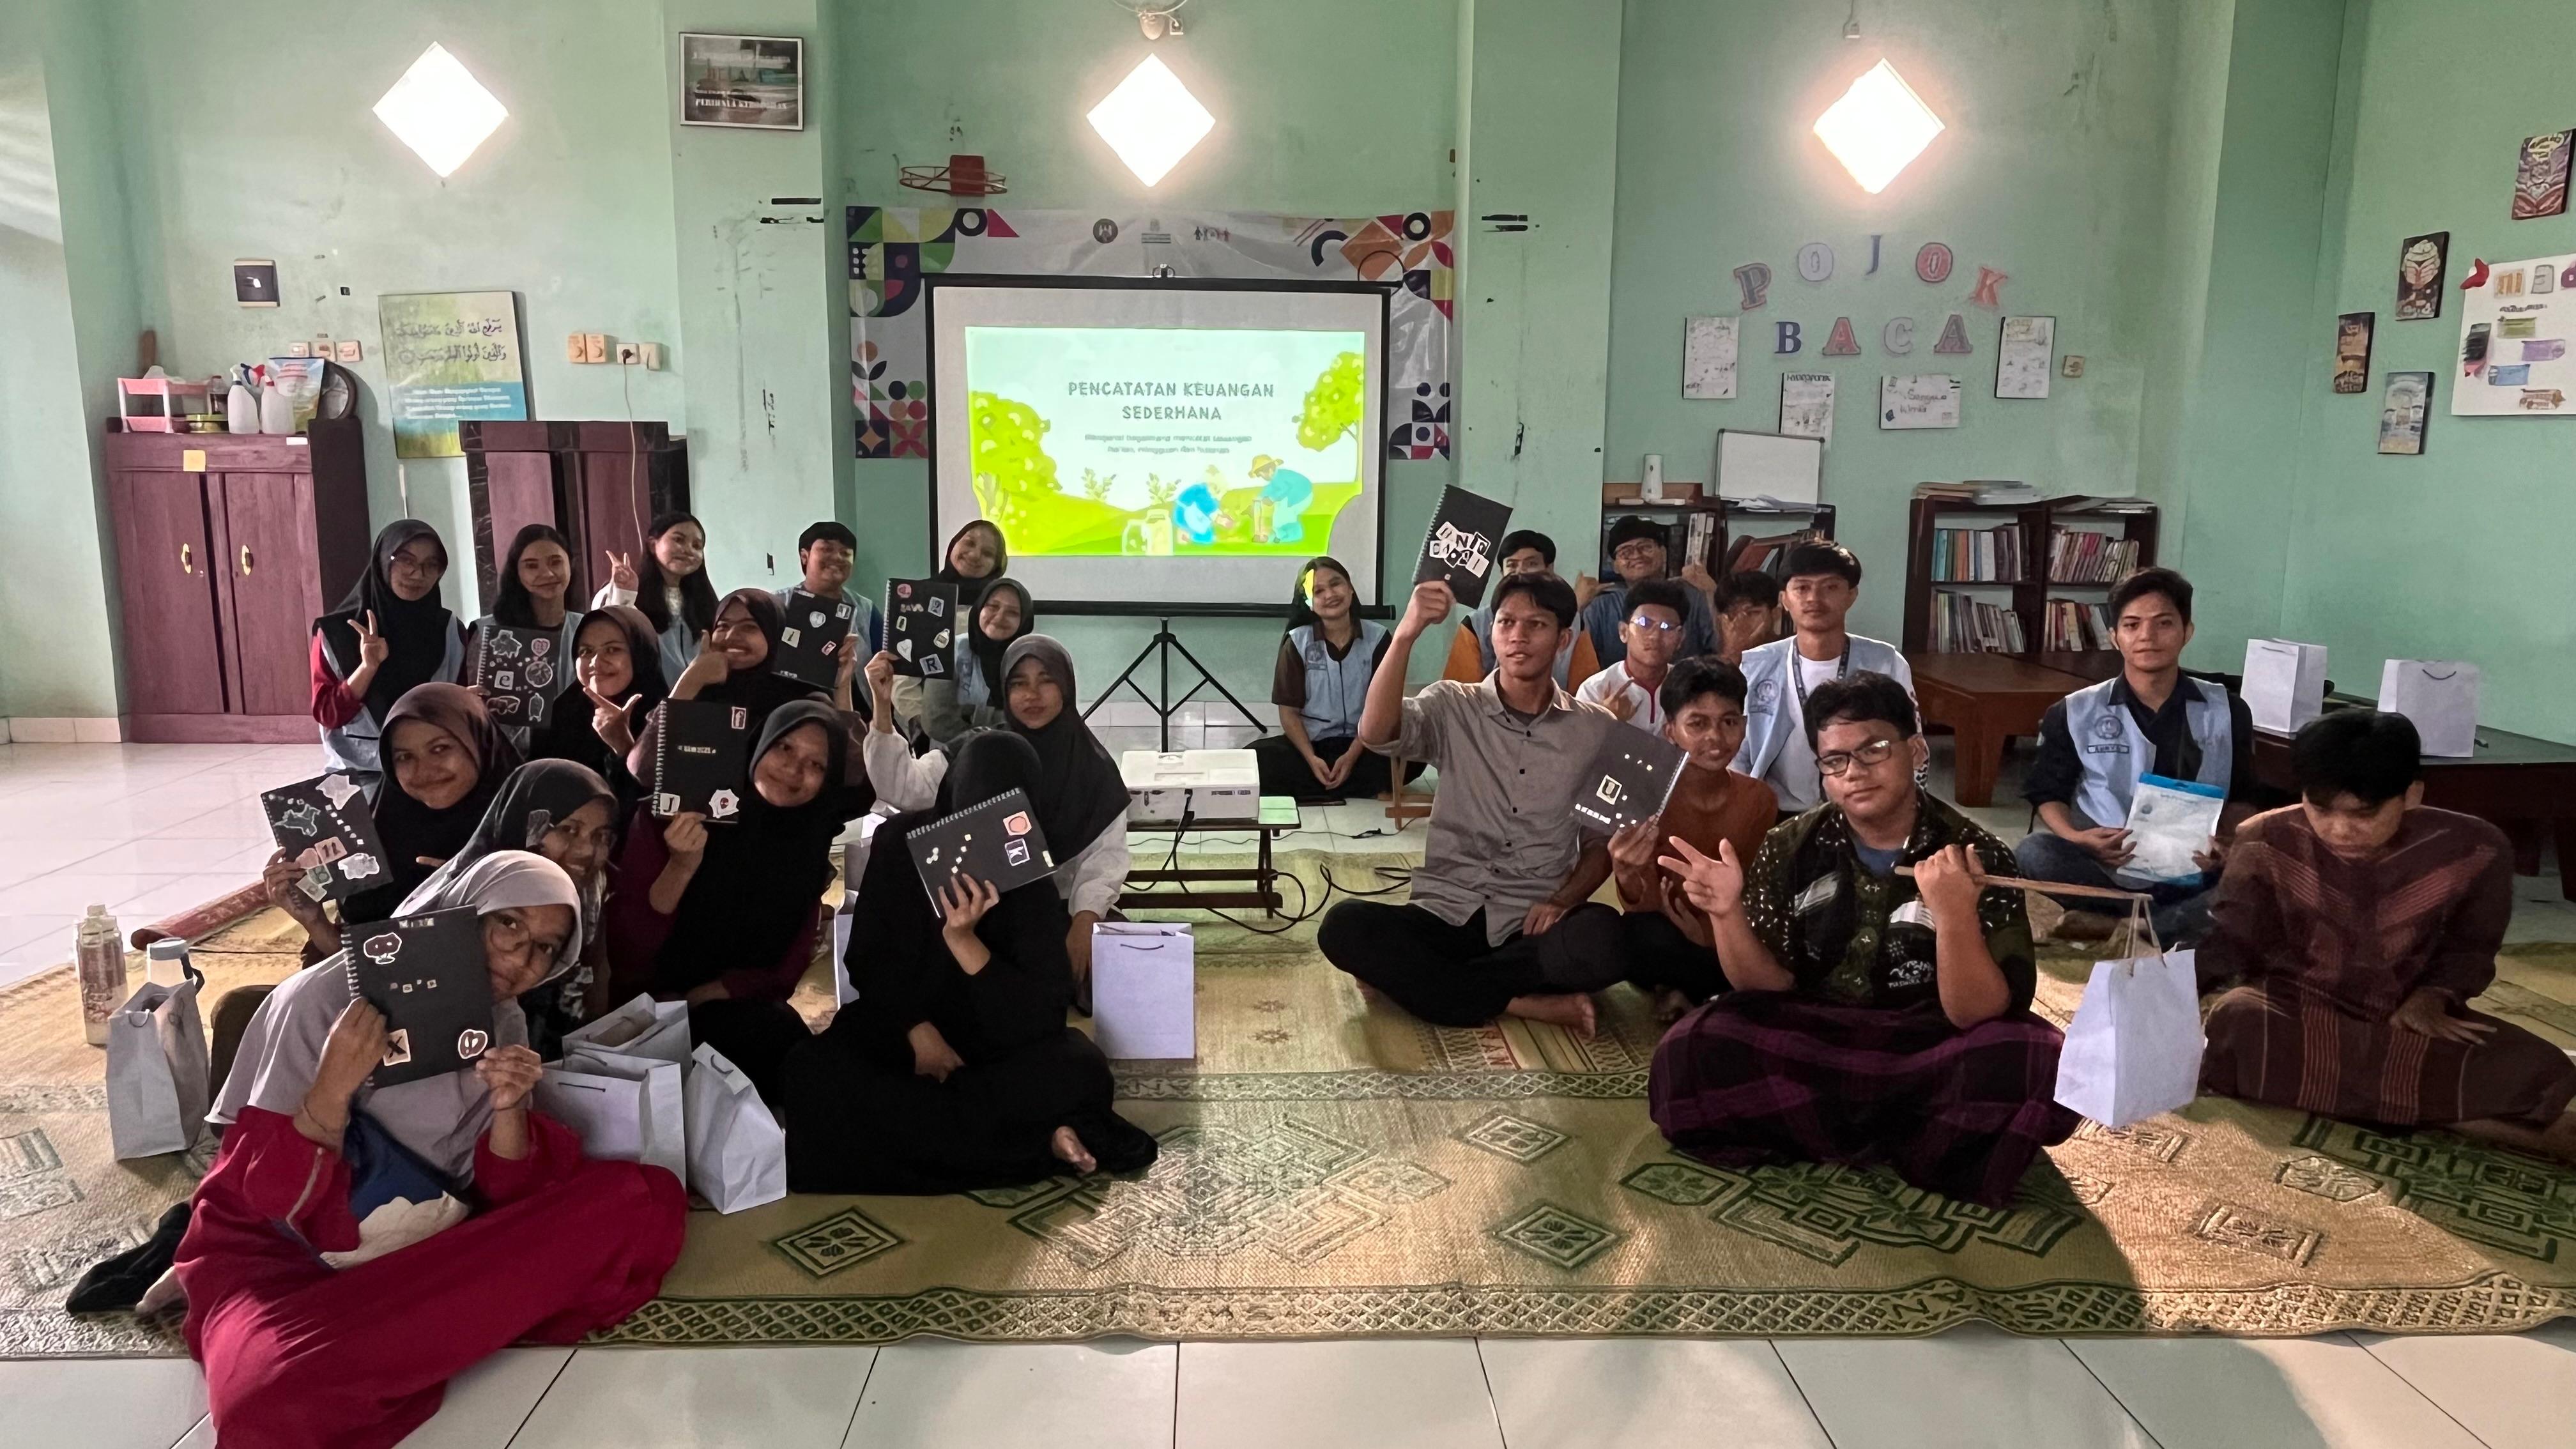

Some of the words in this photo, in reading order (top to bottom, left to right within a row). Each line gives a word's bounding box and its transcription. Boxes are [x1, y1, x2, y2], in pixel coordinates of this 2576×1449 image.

[1733, 234, 2008, 310] POJOK
[1774, 314, 1973, 355] BACA
[1068, 381, 1176, 396] PENCATATAN
[1183, 383, 1274, 397] KEUANGAN
[1123, 406, 1222, 420] SEDERHANA
[926, 657, 938, 671] R
